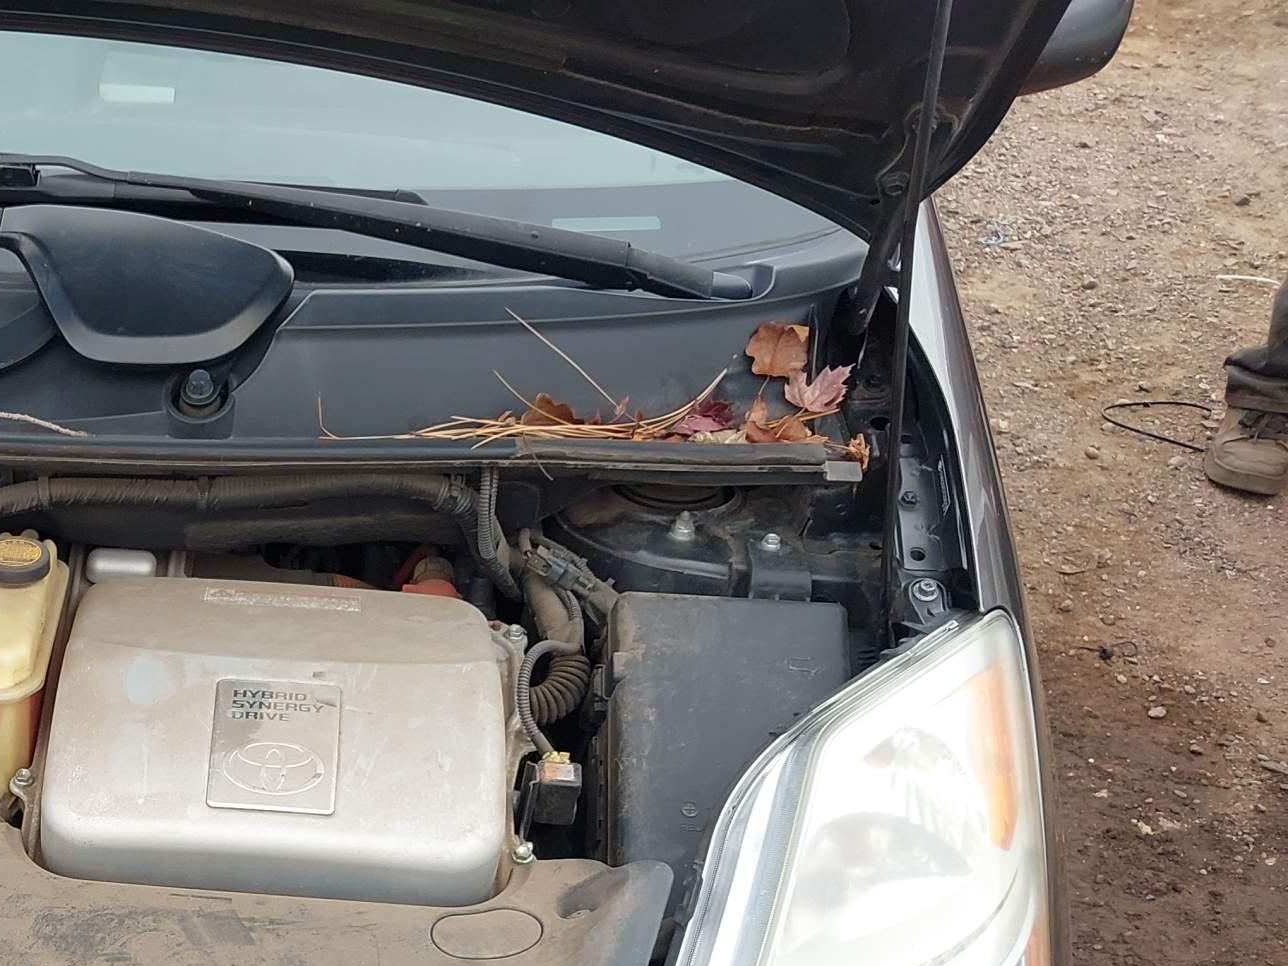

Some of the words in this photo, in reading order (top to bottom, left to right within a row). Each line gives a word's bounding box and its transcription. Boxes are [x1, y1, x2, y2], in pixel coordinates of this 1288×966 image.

[233, 689, 307, 701] HYBRID
[232, 700, 324, 713] SYNERGY
[231, 711, 289, 721] DRIVE
